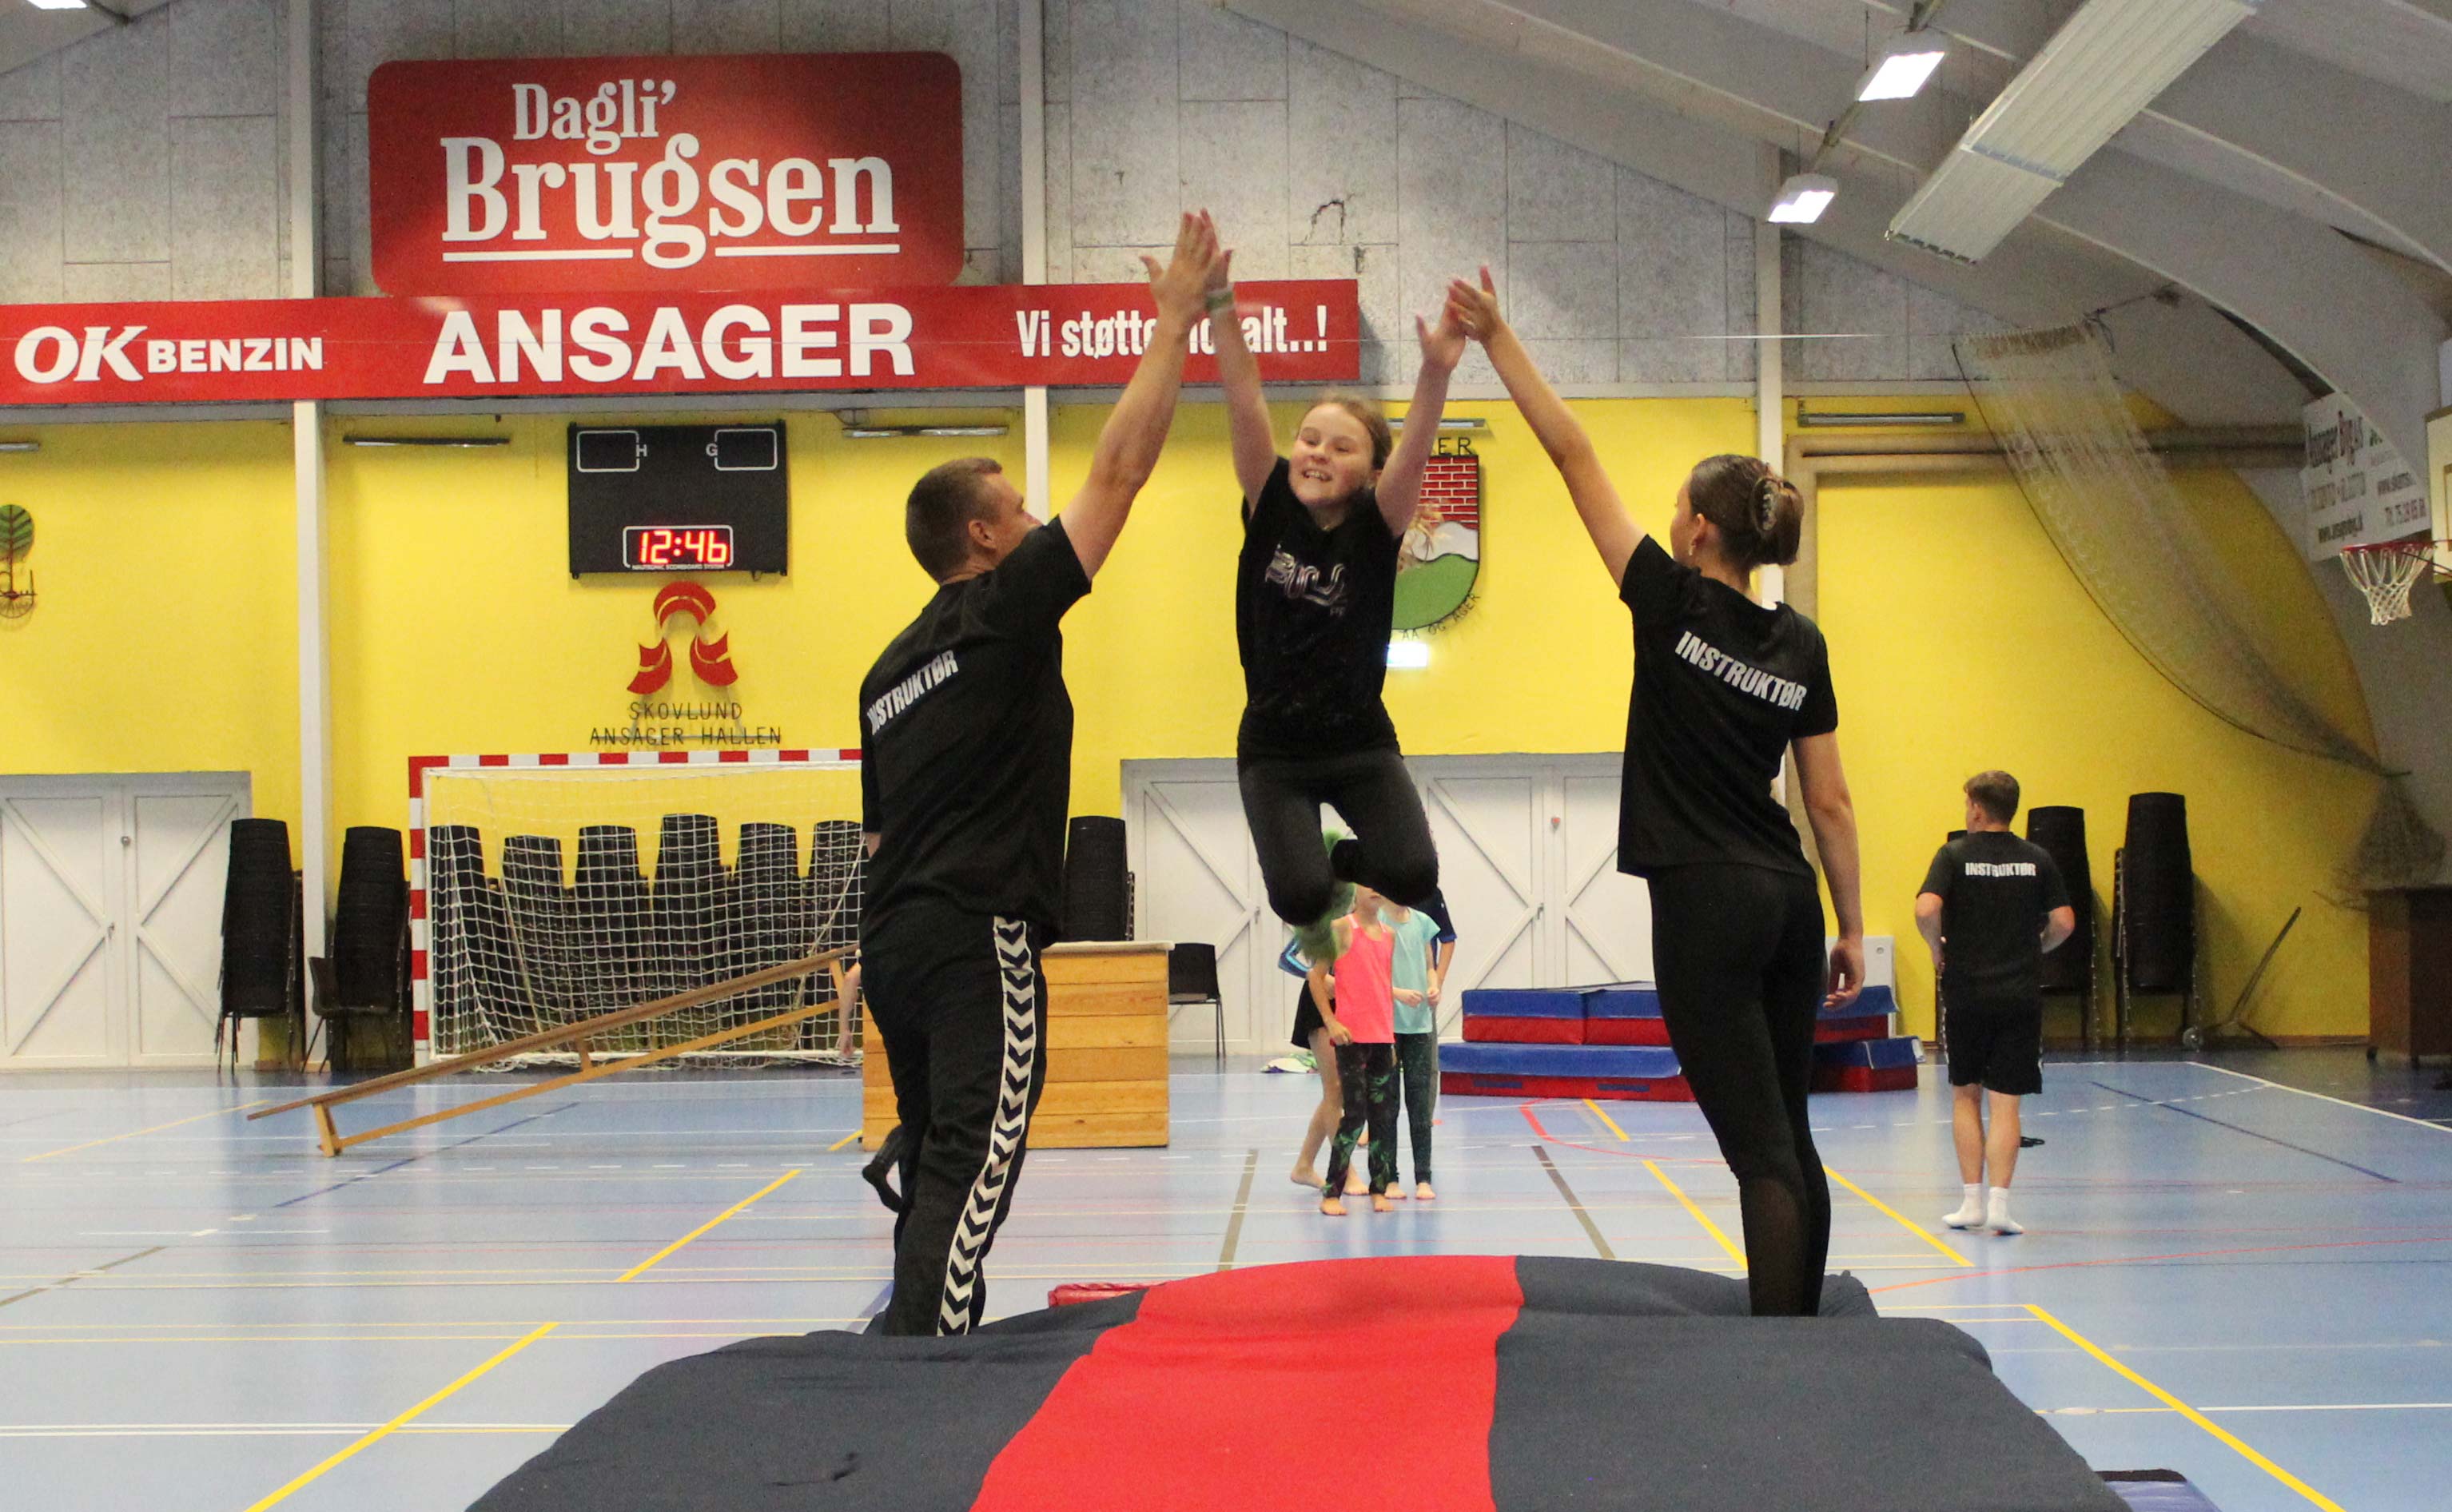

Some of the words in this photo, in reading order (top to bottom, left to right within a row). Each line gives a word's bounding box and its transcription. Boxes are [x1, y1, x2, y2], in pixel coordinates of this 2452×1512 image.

[440, 133, 900, 269] Brugsen
[424, 304, 914, 384] ANSAGER
[1017, 310, 1051, 357] Vi
[1061, 310, 1158, 360] støtte
[14, 325, 147, 384] OK
[148, 336, 323, 373] BENZIN
[636, 444, 647, 457] H
[706, 443, 718, 456] G
[639, 529, 728, 564] 12:46
[1674, 630, 1808, 711] INSTRUKTØR
[628, 702, 742, 720] SKOVLUND
[589, 726, 684, 746] ANSAGER
[701, 726, 782, 746] HALLEN
[1964, 862, 2037, 877] INSTRUKTØR
